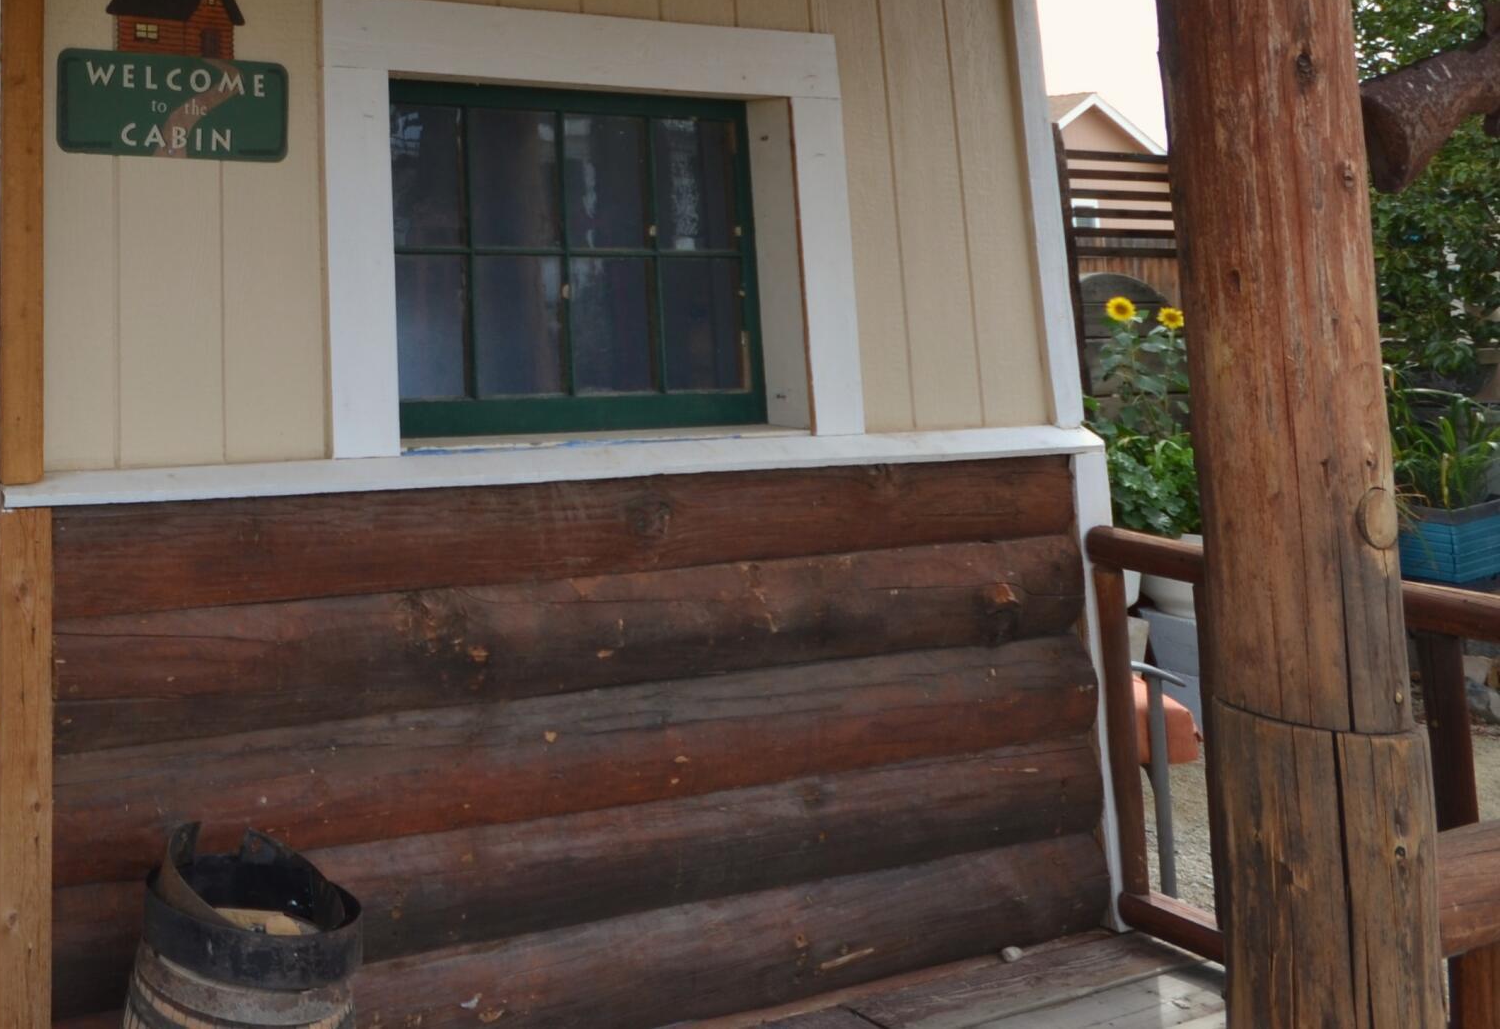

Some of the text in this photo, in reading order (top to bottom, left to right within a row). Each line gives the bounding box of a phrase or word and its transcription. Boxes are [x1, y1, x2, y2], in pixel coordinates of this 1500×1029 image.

[86, 61, 265, 97] WELCOME
[151, 98, 207, 116] to the
[121, 123, 231, 152] CABIN
